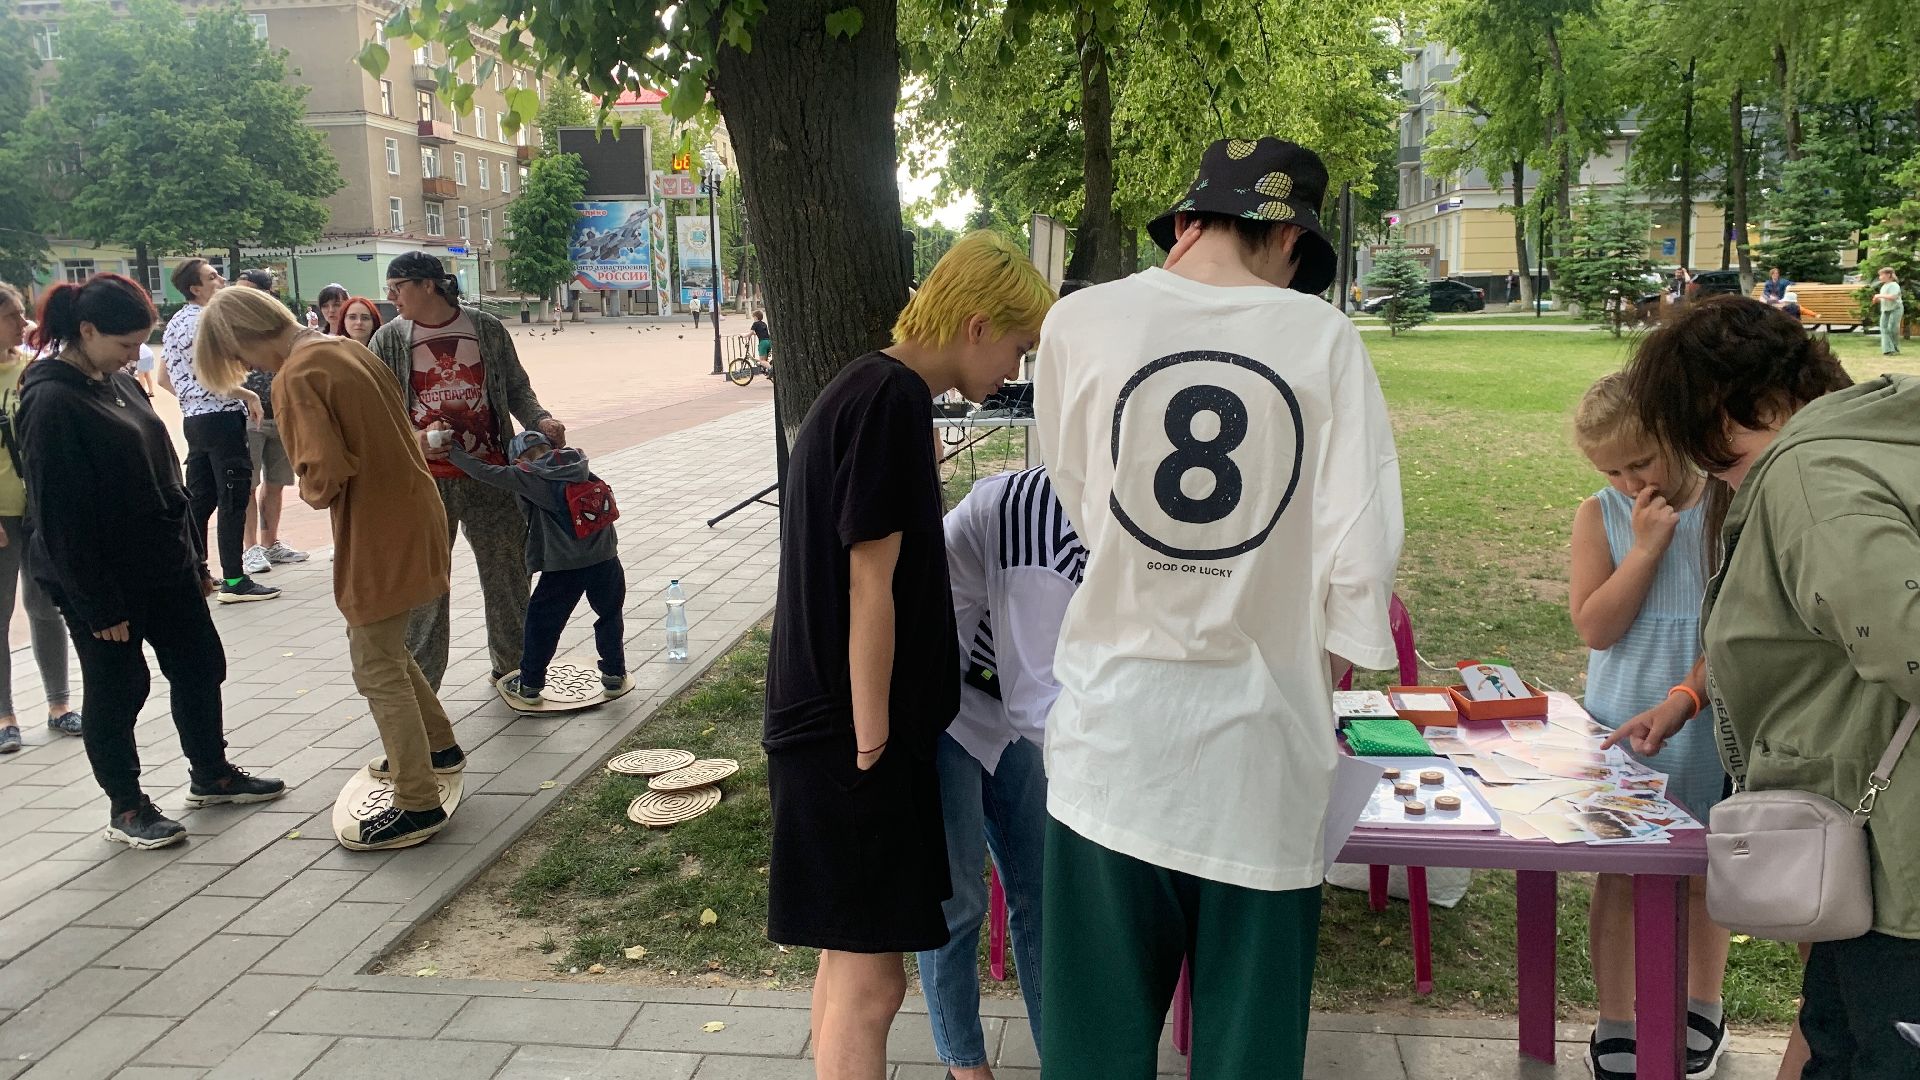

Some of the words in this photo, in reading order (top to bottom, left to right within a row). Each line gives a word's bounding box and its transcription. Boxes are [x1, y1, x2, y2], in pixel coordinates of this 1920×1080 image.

[598, 272, 648, 281] РОССИИ
[1153, 384, 1249, 524] 8
[1147, 561, 1178, 571] GOOD
[1181, 564, 1197, 573] OR
[1199, 566, 1233, 578] LUCKY
[1814, 591, 1825, 606] A
[1856, 625, 1870, 638] W
[1906, 660, 1920, 675] P
[1714, 697, 1744, 772] BEAUTIFUL
